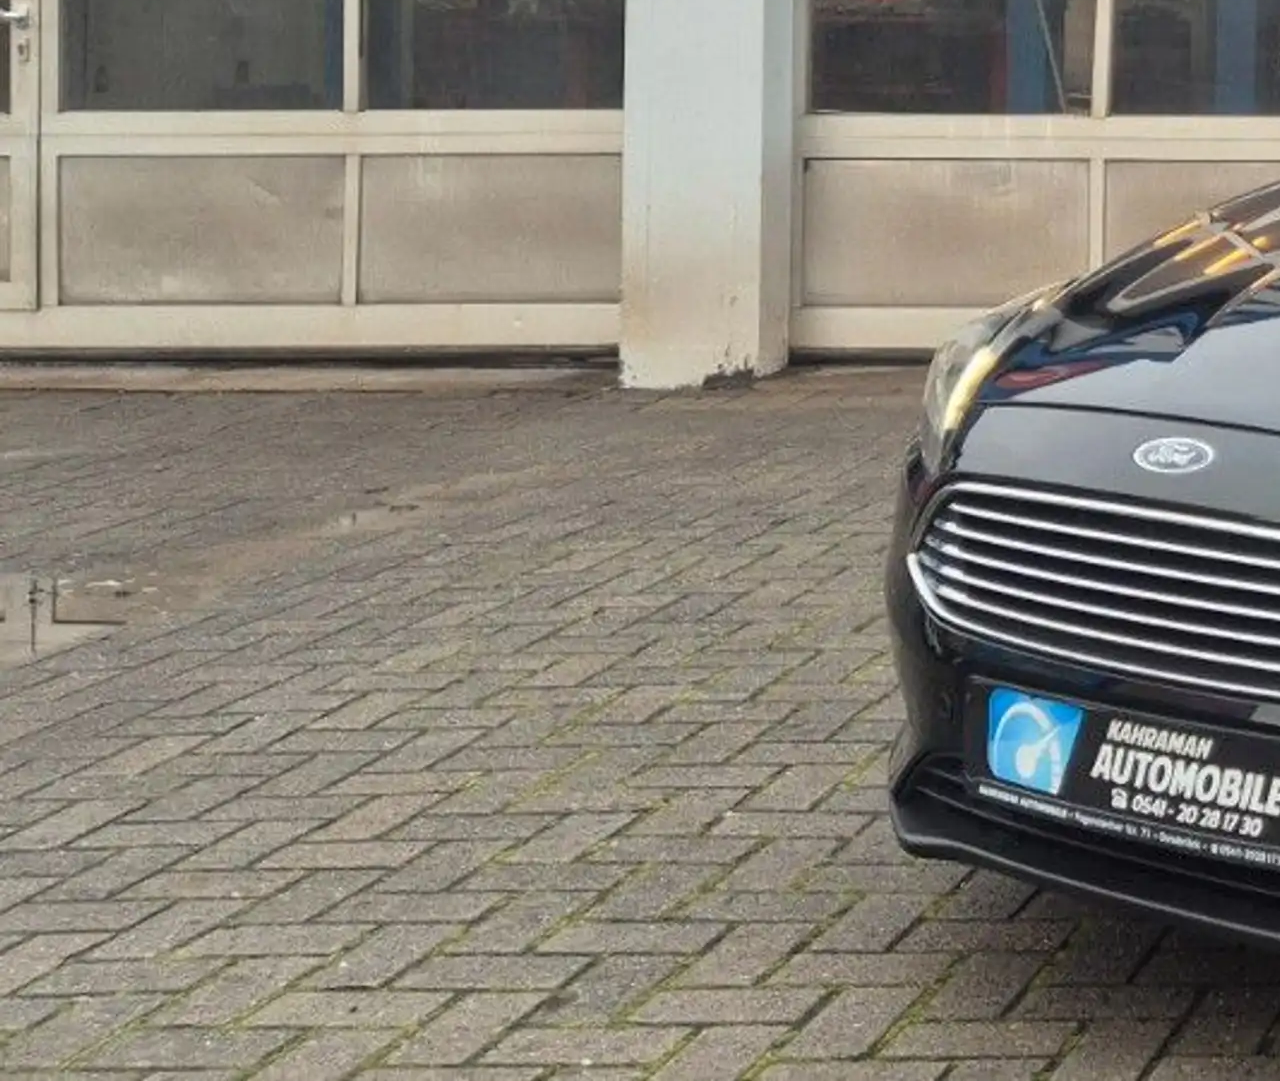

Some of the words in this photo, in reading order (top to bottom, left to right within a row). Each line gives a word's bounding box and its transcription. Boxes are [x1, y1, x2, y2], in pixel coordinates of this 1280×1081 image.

[1107, 719, 1213, 760] KAHRAMAN
[1132, 794, 1168, 818] 0541
[1176, 803, 1198, 824] 20
[1200, 808, 1221, 830] 28
[1222, 813, 1239, 835] 17
[1239, 815, 1263, 838] 30
